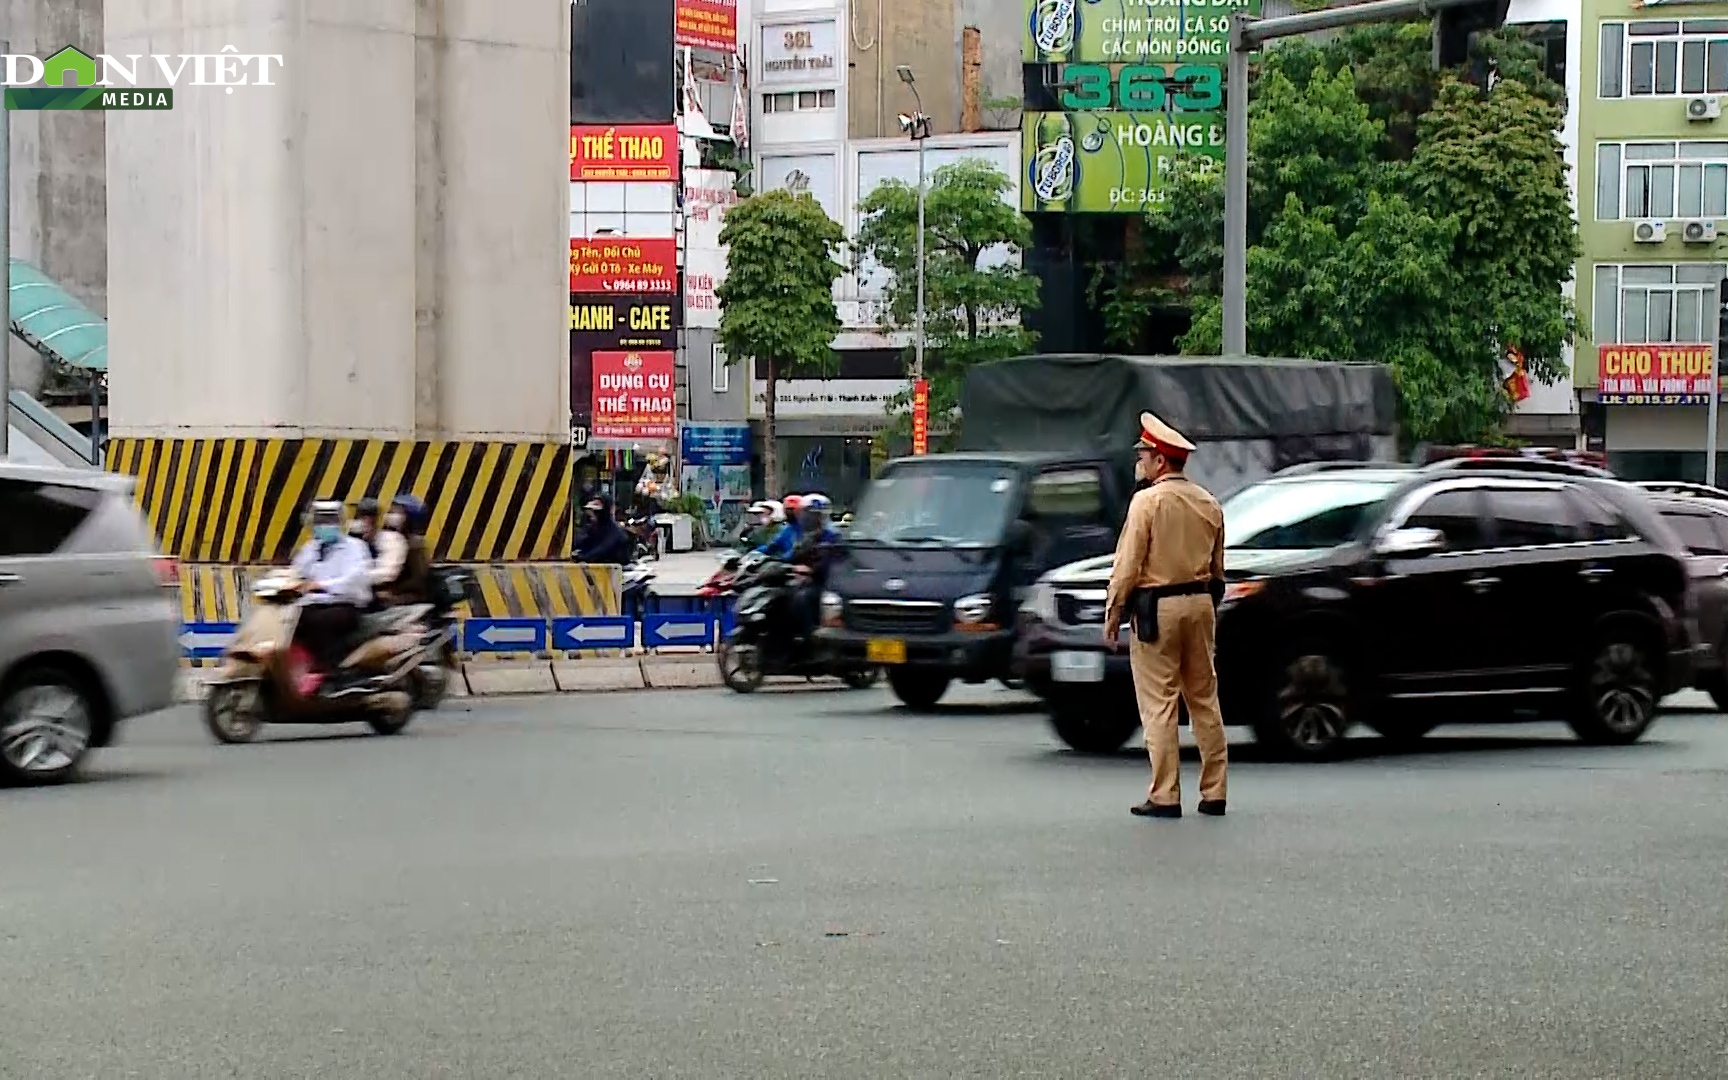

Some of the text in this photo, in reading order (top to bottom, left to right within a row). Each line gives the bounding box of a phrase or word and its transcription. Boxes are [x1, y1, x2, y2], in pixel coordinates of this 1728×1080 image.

[1102, 19, 1141, 32] CHIM
[1185, 16, 1204, 32] CÁ
[1102, 38, 1131, 54] CÁC
[1136, 39, 1172, 54] MÓN
[1063, 65, 1222, 110] 363
[1118, 120, 1203, 146] HOÀNG
[582, 127, 614, 159] THỂ
[618, 137, 663, 160] THAO
[1139, 188, 1165, 203] 363
[628, 264, 641, 274] Xe
[642, 263, 663, 277] Máy
[613, 280, 636, 291] 0964
[630, 305, 671, 330] CAFE
[1606, 350, 1652, 375] CHO
[599, 374, 670, 392] DỤNG CỤ
[598, 391, 672, 412] THỂ THAO
